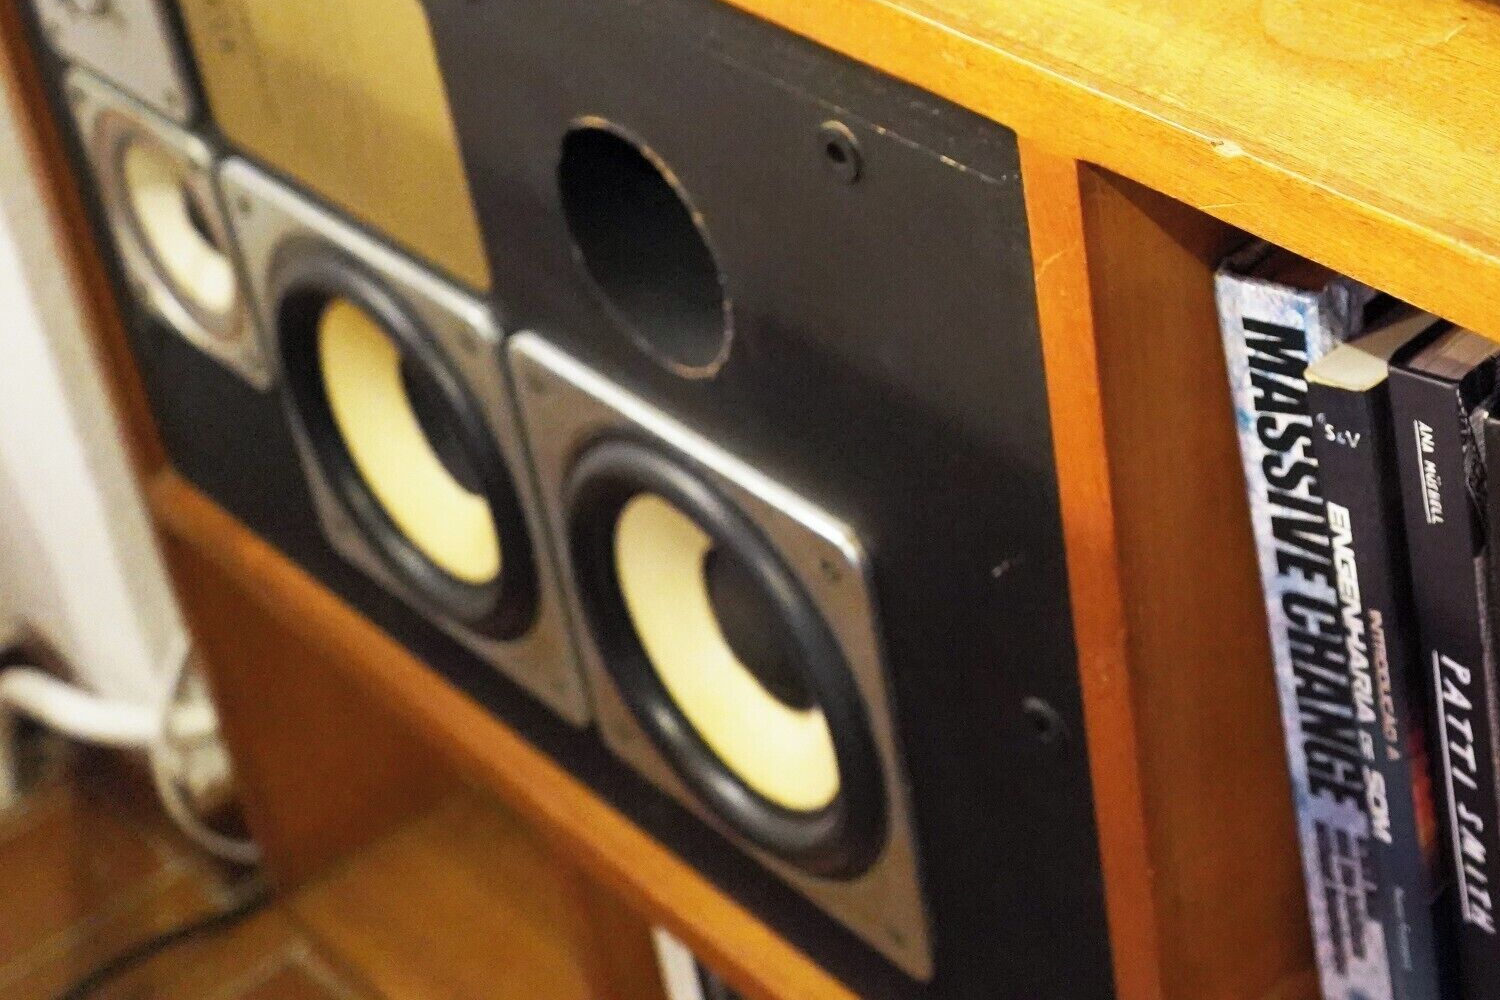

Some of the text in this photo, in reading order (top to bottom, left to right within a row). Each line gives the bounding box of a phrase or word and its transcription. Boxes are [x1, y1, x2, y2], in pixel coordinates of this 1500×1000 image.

[1242, 316, 1336, 588] MASSIVE
[1417, 420, 1435, 453] ANA
[1284, 588, 1366, 809] CHANGE
[1326, 501, 1376, 722] ENGENHARIA
[1361, 765, 1393, 844] SOM
[1439, 654, 1497, 935] PATTI SMITH
